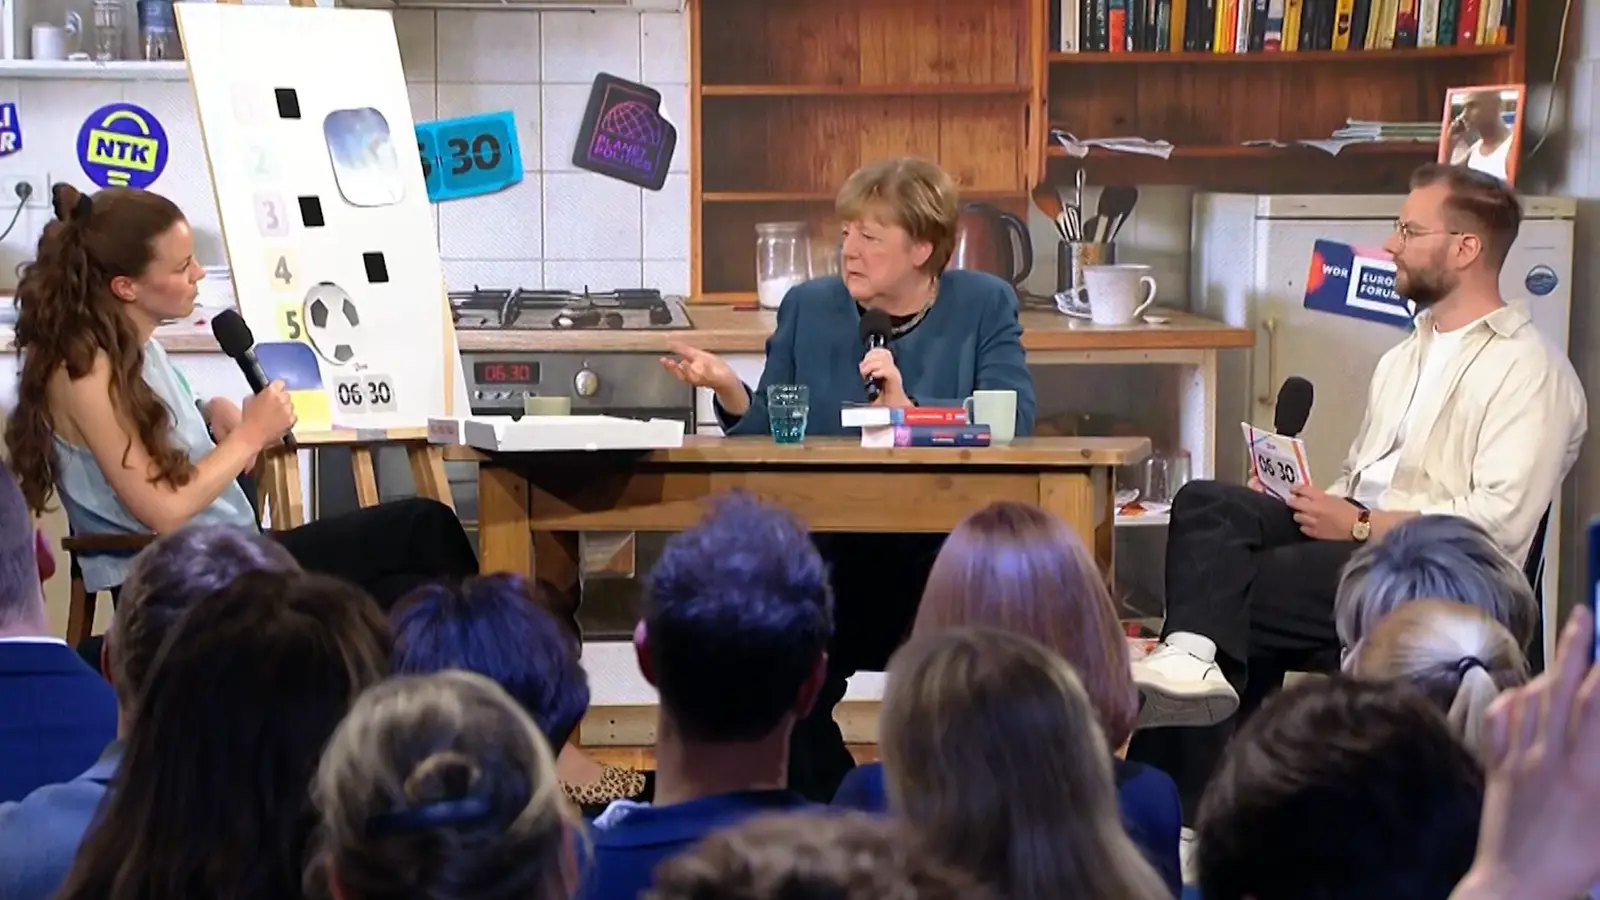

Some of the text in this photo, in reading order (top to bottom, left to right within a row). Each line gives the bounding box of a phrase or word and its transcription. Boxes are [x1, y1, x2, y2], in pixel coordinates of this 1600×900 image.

[96, 137, 150, 164] NTK
[447, 134, 502, 175] 30
[260, 199, 279, 230] 3
[274, 255, 293, 285] 4
[1322, 263, 1348, 279] WDR
[1362, 271, 1396, 287] EURO
[286, 310, 301, 339] 5
